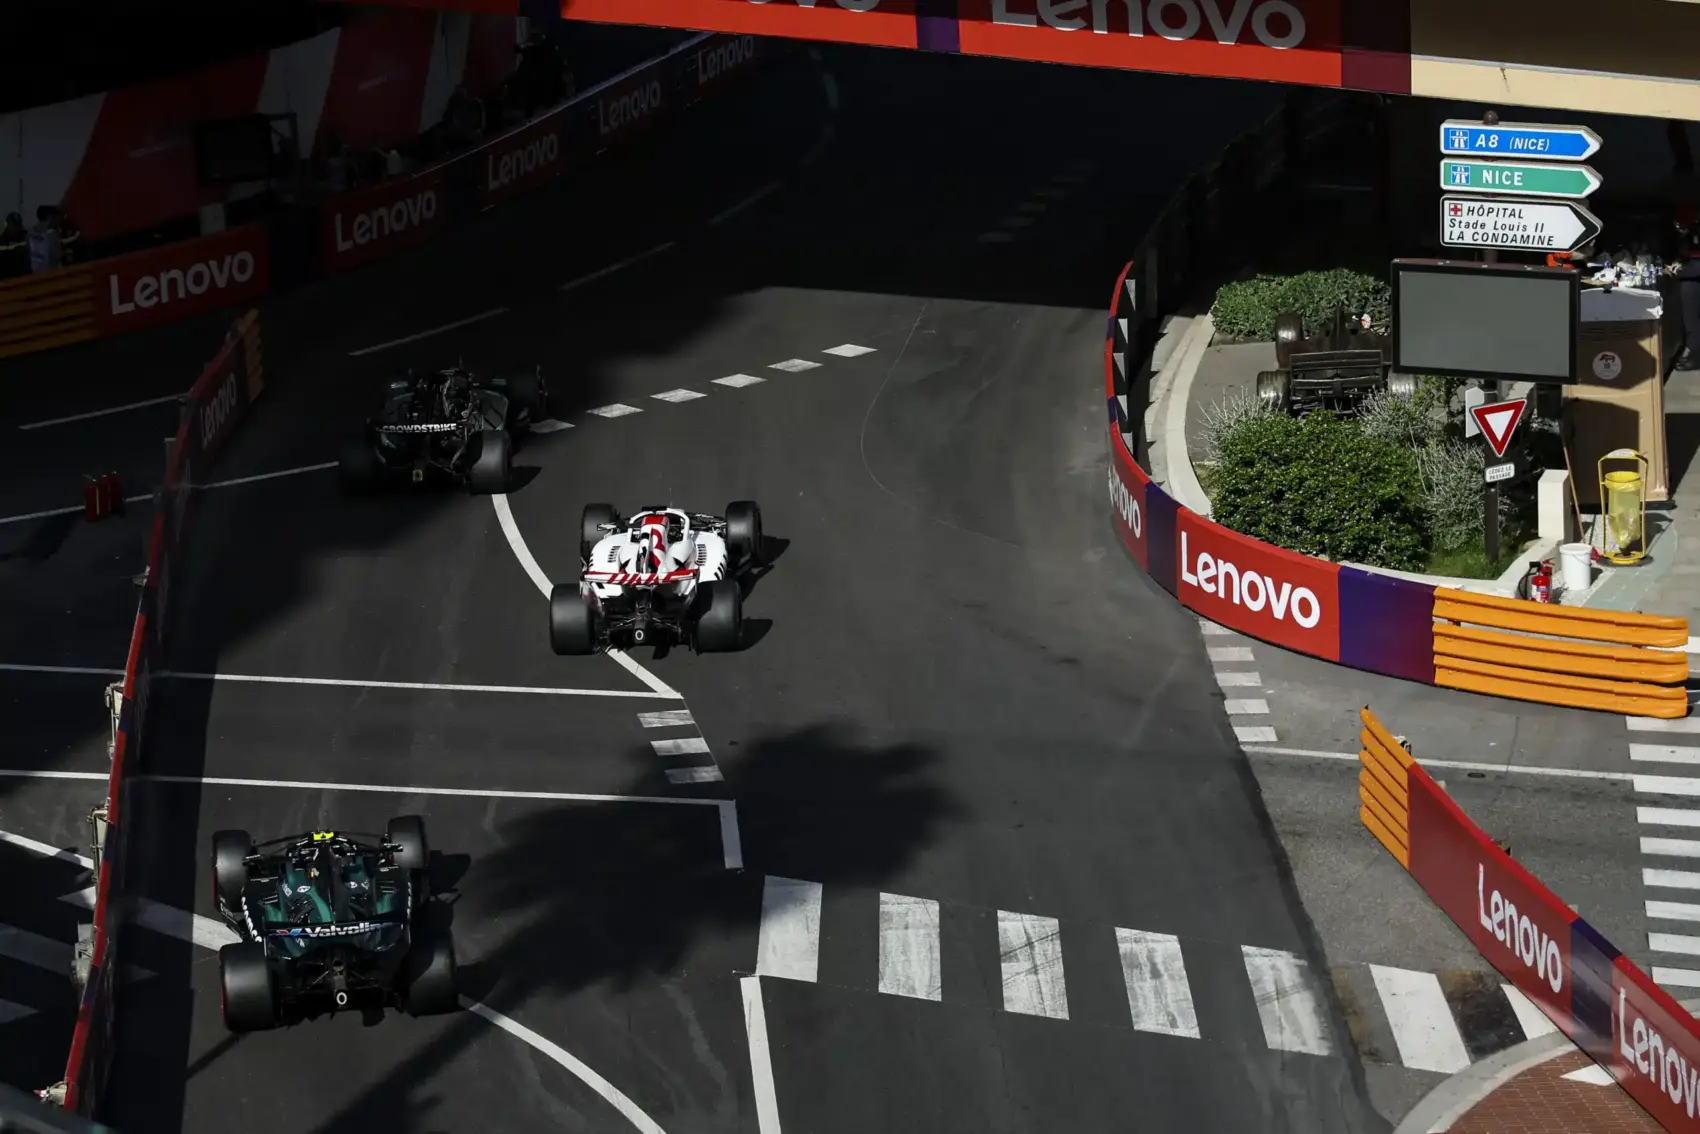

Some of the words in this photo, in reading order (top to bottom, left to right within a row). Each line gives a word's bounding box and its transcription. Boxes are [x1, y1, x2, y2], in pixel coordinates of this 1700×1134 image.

[699, 35, 754, 85] Lenovo
[599, 79, 661, 134] Lenovo
[488, 132, 558, 191] Lenovo
[1476, 134, 1499, 148] A8
[1509, 137, 1550, 152] (NICE)
[1482, 169, 1523, 186] NICE
[334, 190, 437, 252] Lenovo
[1449, 218, 1486, 230] Stade
[1493, 221, 1528, 232] Louis
[1466, 204, 1524, 219] HÔPITAL
[1449, 231, 1465, 241] LA
[1471, 232, 1554, 246] CONDAMINE
[109, 250, 255, 315] Lenovo
[200, 372, 237, 450] Lenovo
[382, 423, 457, 433] CROWDSTRIKE
[1181, 531, 1320, 629] Lenovo
[305, 921, 390, 938] Valvolin
[1478, 862, 1563, 993] Lenovo
[1619, 987, 1700, 1119] Lenov
